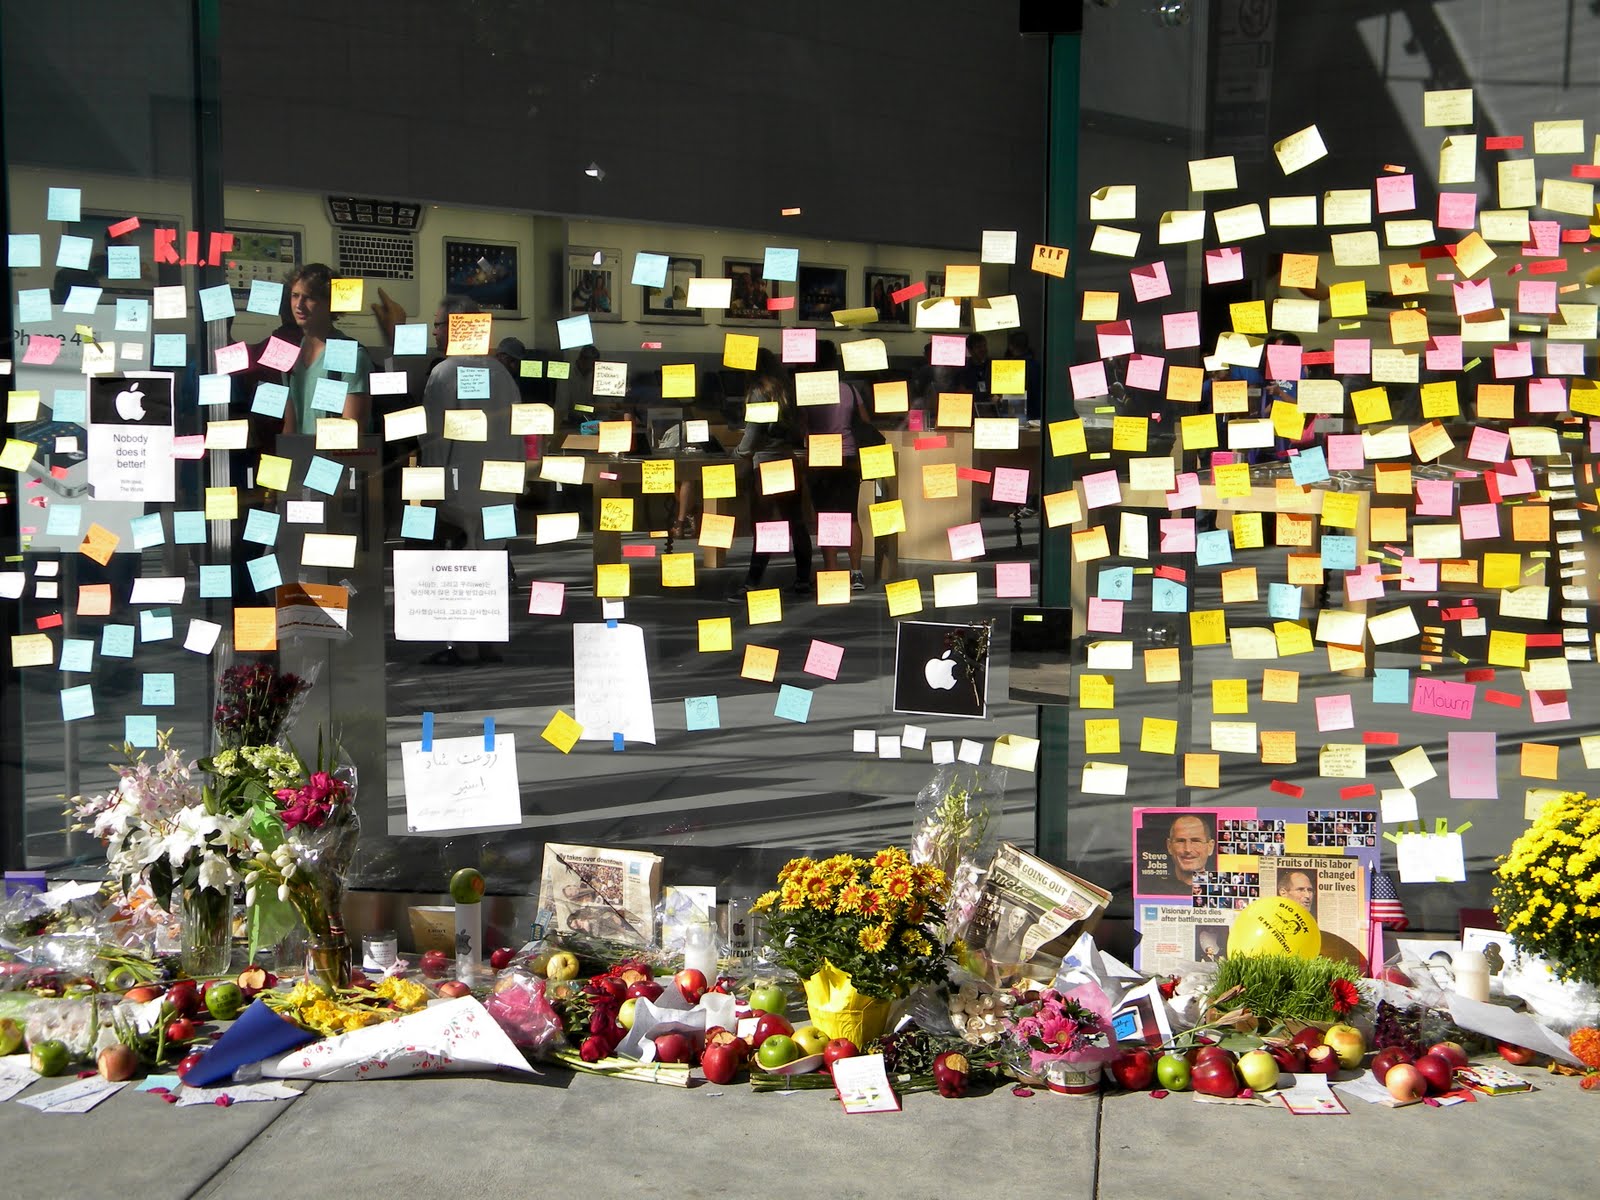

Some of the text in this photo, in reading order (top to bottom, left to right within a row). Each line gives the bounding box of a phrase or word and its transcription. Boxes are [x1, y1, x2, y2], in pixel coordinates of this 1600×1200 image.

[1039, 247, 1064, 260] RIP
[14, 330, 66, 346] Phe
[113, 434, 148, 444] Nobody
[116, 448, 147, 456] does it
[117, 460, 146, 468] better!
[1418, 685, 1470, 710] iMourn
[1142, 852, 1168, 860] Steve
[1147, 861, 1168, 869] Jobs
[1277, 858, 1302, 867] Fruits
[1304, 859, 1313, 867] of
[1314, 859, 1327, 868] his
[1329, 860, 1352, 869] labor
[1021, 864, 1068, 896] GOING OUT
[1318, 870, 1355, 881] changed
[1335, 882, 1356, 892] lives
[1279, 902, 1309, 934] BIG NICK
[1263, 921, 1272, 930] MY
[1271, 930, 1292, 954] FRIEND!
